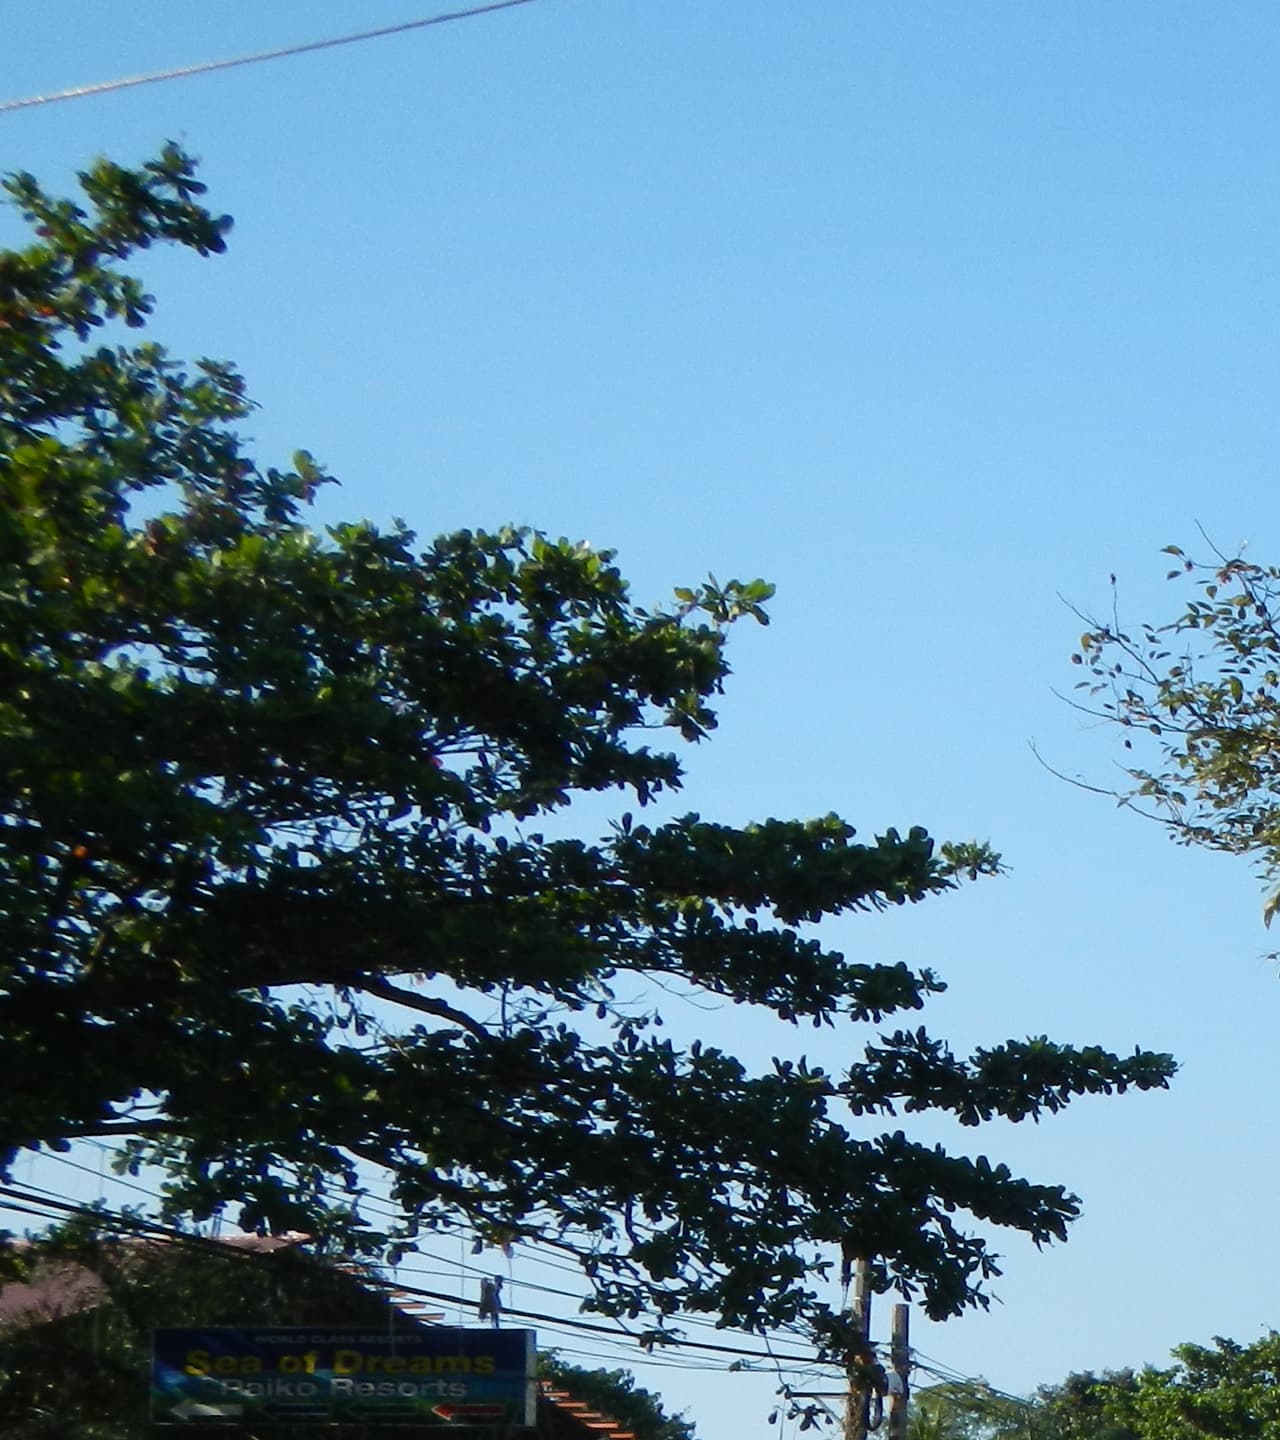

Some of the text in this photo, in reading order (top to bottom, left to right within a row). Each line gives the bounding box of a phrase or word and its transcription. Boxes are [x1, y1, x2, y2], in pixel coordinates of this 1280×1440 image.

[183, 1348, 496, 1377] Sea of Dreams
[330, 1377, 469, 1398] Resorts
